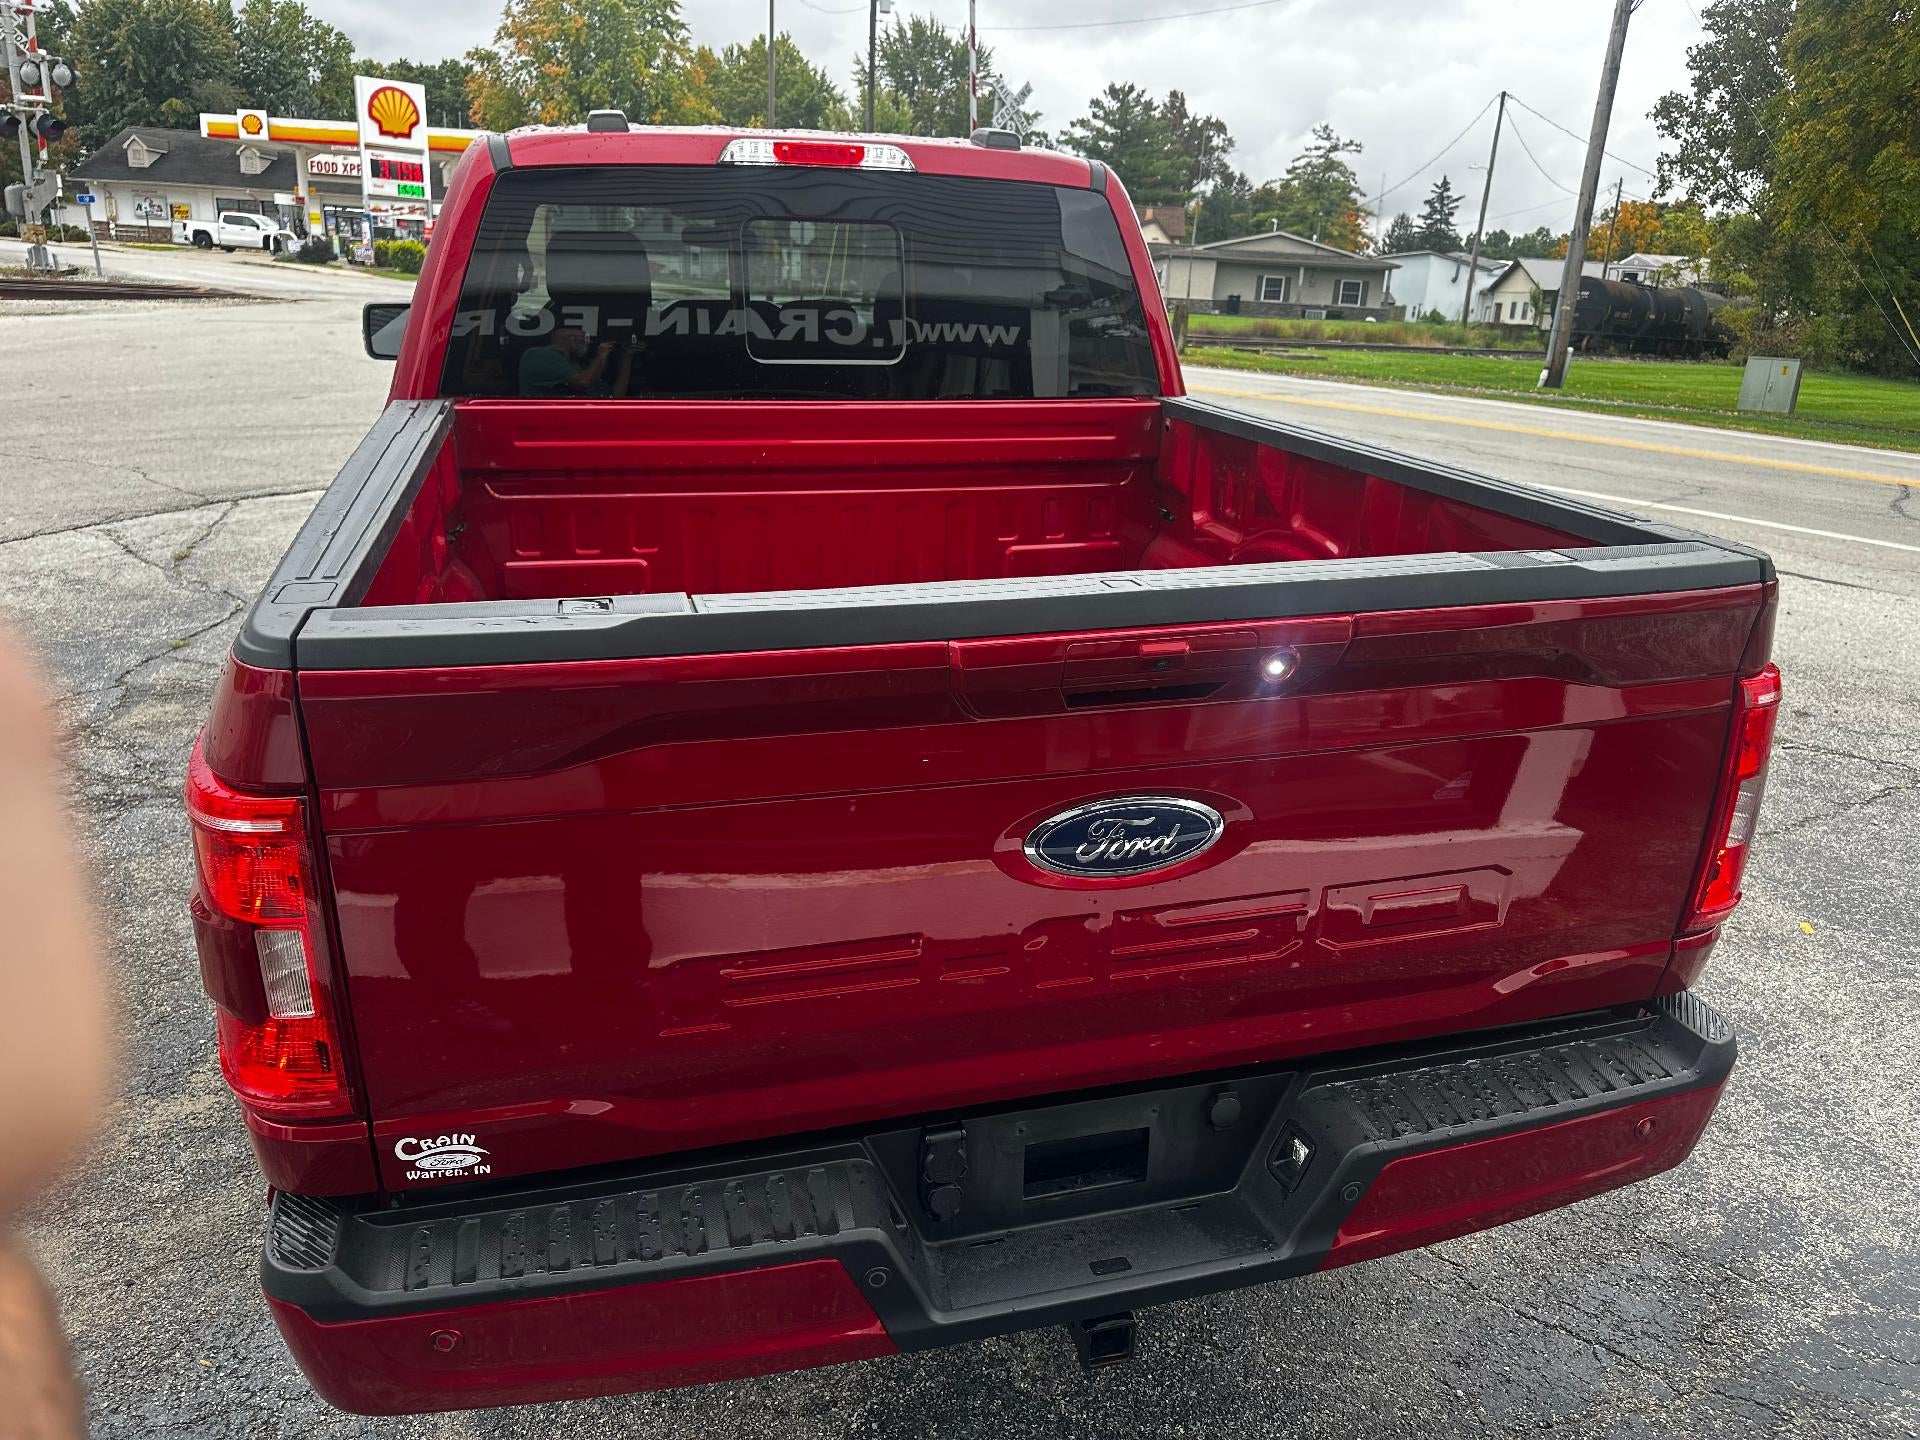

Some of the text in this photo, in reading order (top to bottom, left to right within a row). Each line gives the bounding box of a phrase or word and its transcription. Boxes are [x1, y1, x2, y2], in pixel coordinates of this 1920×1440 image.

[995, 83, 1031, 126] CROSSING
[310, 160, 338, 173] FOOD
[1075, 816, 1181, 864] Ford
[429, 1157, 466, 1167] Ford
[474, 1164, 491, 1175] IN
